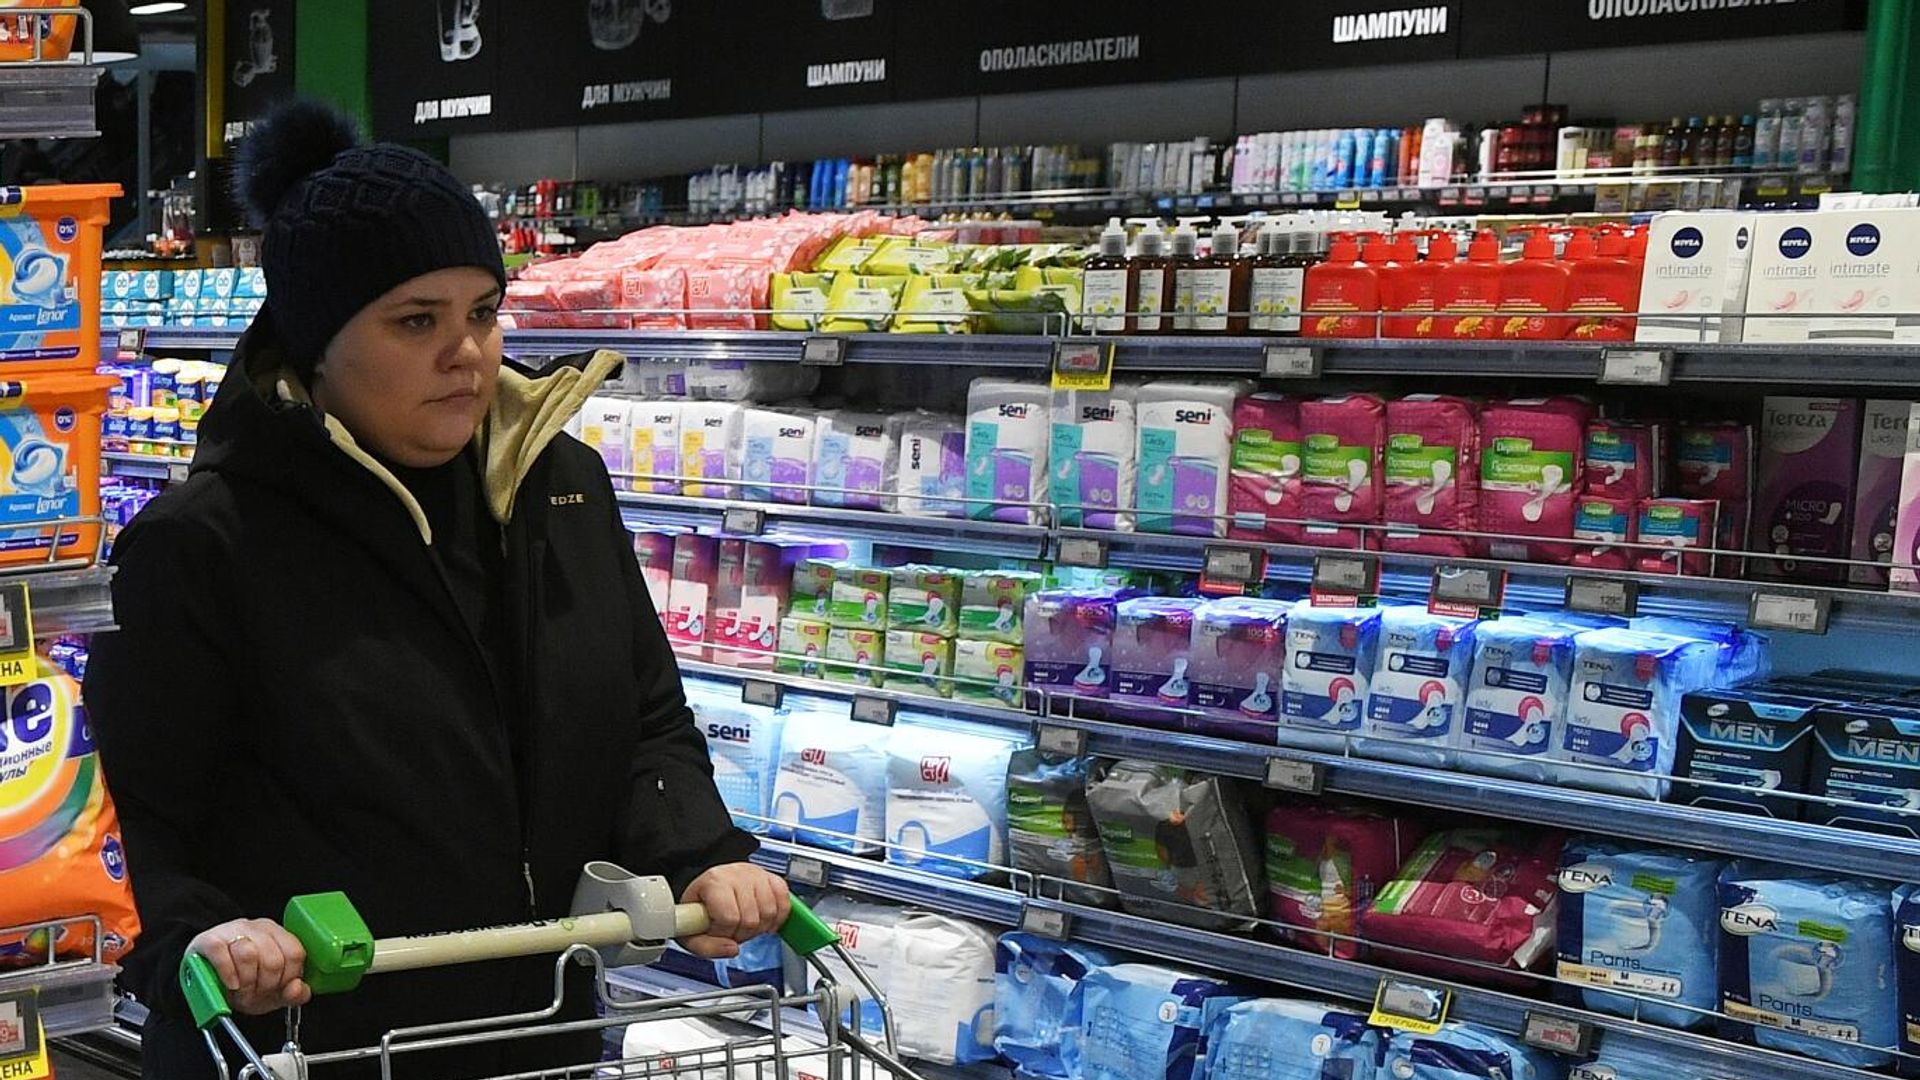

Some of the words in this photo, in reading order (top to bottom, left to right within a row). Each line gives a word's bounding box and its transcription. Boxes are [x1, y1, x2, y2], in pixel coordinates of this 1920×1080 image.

[1332, 6, 1448, 43] ШАМПУНИ
[979, 34, 1140, 72] ОПОЛАСКИВАТЕЛИ
[807, 58, 886, 87] ШАМПУНИ
[581, 84, 610, 109] ДЛЯ
[612, 79, 672, 103] МУЖЧИН
[413, 100, 439, 124] ДЛЯ
[440, 94, 492, 119] МУЖЧИН
[1673, 238, 1701, 248] NIVEA
[1781, 238, 1809, 248] NIVEA
[1848, 235, 1877, 246] NIVEA
[1655, 262, 1713, 276] intimate
[1830, 261, 1891, 275] intimate
[37, 307, 69, 327] Lenor
[998, 404, 1028, 418] seni
[1082, 405, 1116, 421] seni
[1175, 408, 1213, 423] seni
[1768, 409, 1827, 427] Tereza
[779, 427, 805, 437] seni
[855, 424, 884, 437] seni
[550, 493, 585, 506] EDZE
[0, 660, 23, 678] НА
[1582, 660, 1615, 672] TENA
[708, 722, 751, 740] seni
[1709, 721, 1776, 745] MEN
[1848, 738, 1920, 763] MEN
[1560, 869, 1613, 887] TENA
[1721, 908, 1778, 931] TENA
[1590, 950, 1641, 970] Pants
[1758, 993, 1813, 1018] Pants
[0, 1060, 33, 1080] ЕНА
